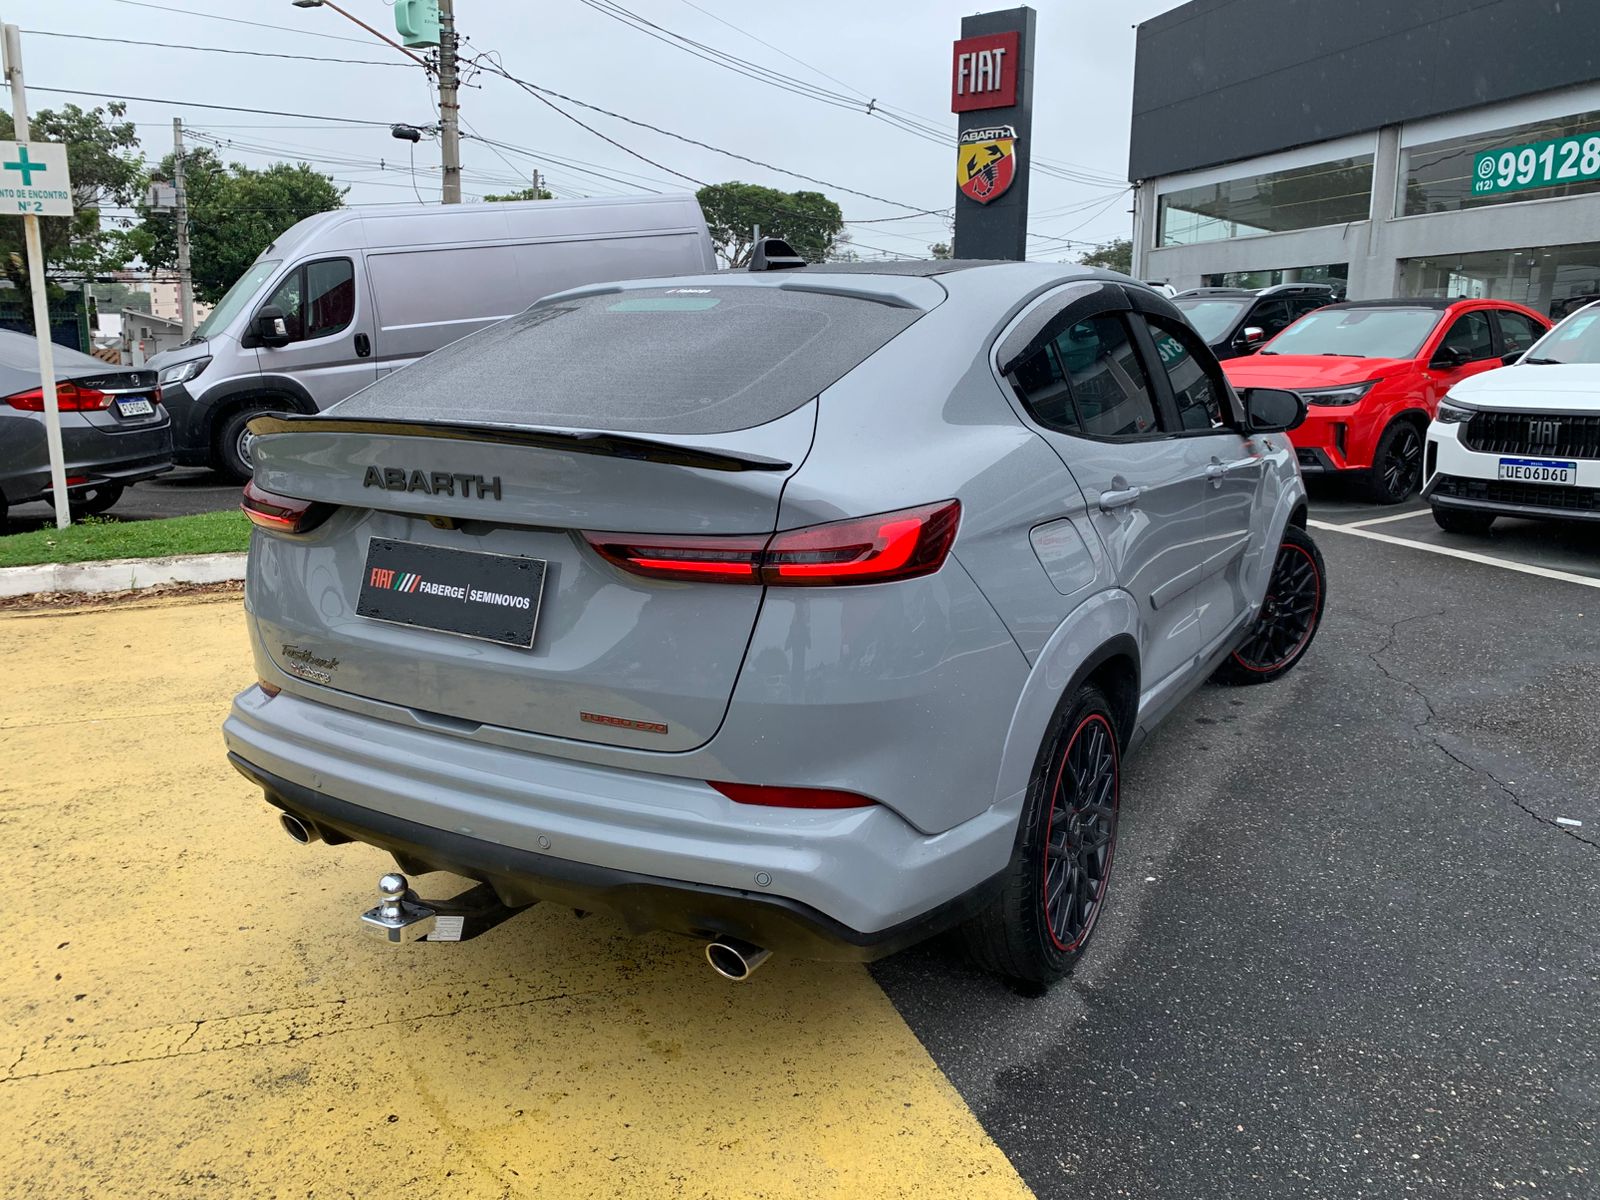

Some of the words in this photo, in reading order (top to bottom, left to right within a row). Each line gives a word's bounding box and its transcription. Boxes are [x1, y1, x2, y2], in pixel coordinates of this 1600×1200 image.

[957, 47, 1006, 95] FIAT
[961, 129, 1010, 142] ABARTH
[1475, 179, 1493, 191] (12)
[1496, 136, 1600, 187] 99128
[16, 189, 26, 198] DE
[28, 190, 68, 200] ENCONTRO
[33, 201, 43, 212] 2
[1528, 420, 1562, 445] FIAT
[362, 464, 502, 501] ABARTH
[369, 567, 396, 590] FIAT
[419, 581, 466, 599] FABERGE
[469, 589, 531, 609] SEMINOVOS
